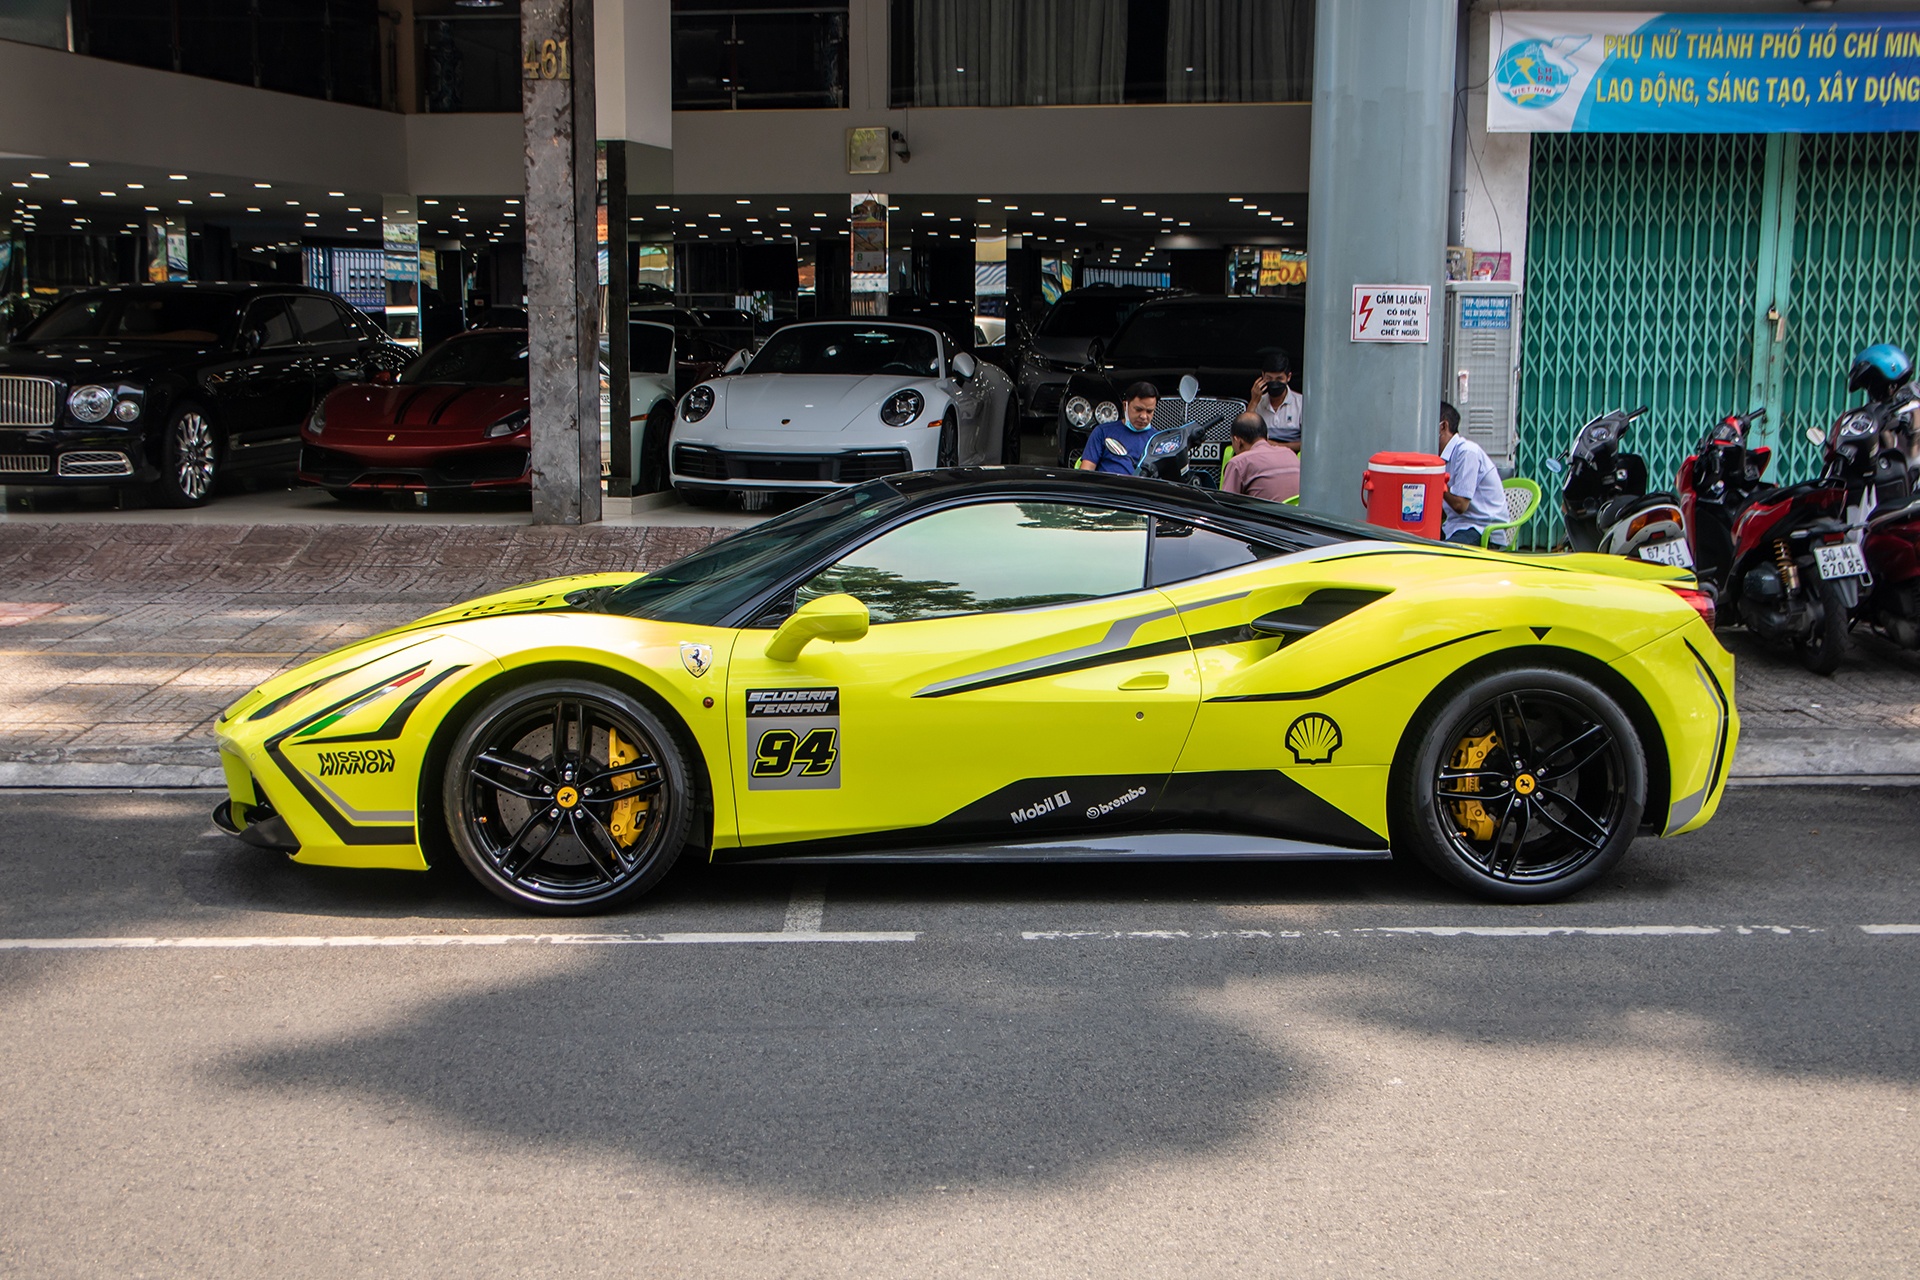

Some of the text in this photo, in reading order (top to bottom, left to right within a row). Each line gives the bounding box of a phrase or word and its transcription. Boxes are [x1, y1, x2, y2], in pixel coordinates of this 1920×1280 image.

[1603, 34, 1644, 64] PHỤ
[1651, 28, 1682, 59] NỮ
[1686, 26, 1754, 59] THÀNH
[1759, 23, 1805, 59] PHỐ
[1807, 22, 1838, 58] HỒ
[1843, 25, 1882, 58] CHÍ
[523, 38, 570, 79] 461
[1595, 69, 1920, 108] LAO ĐỘNG, SÁNG TẠO, XÂY DỰNG
[1376, 291, 1394, 304] CẤM
[1396, 295, 1407, 306] LẠI
[1386, 307, 1397, 316] CÓ
[1380, 328, 1399, 336] CHẾT
[1822, 559, 1863, 577] 620.85
[748, 690, 837, 702] SCUDERIA
[751, 702, 829, 714] FERRARI
[317, 748, 395, 763] MISSION
[751, 728, 838, 778] 94
[320, 761, 395, 776] WINNOW
[1010, 791, 1071, 824] Mobil 1
[1098, 786, 1147, 815] brembo
